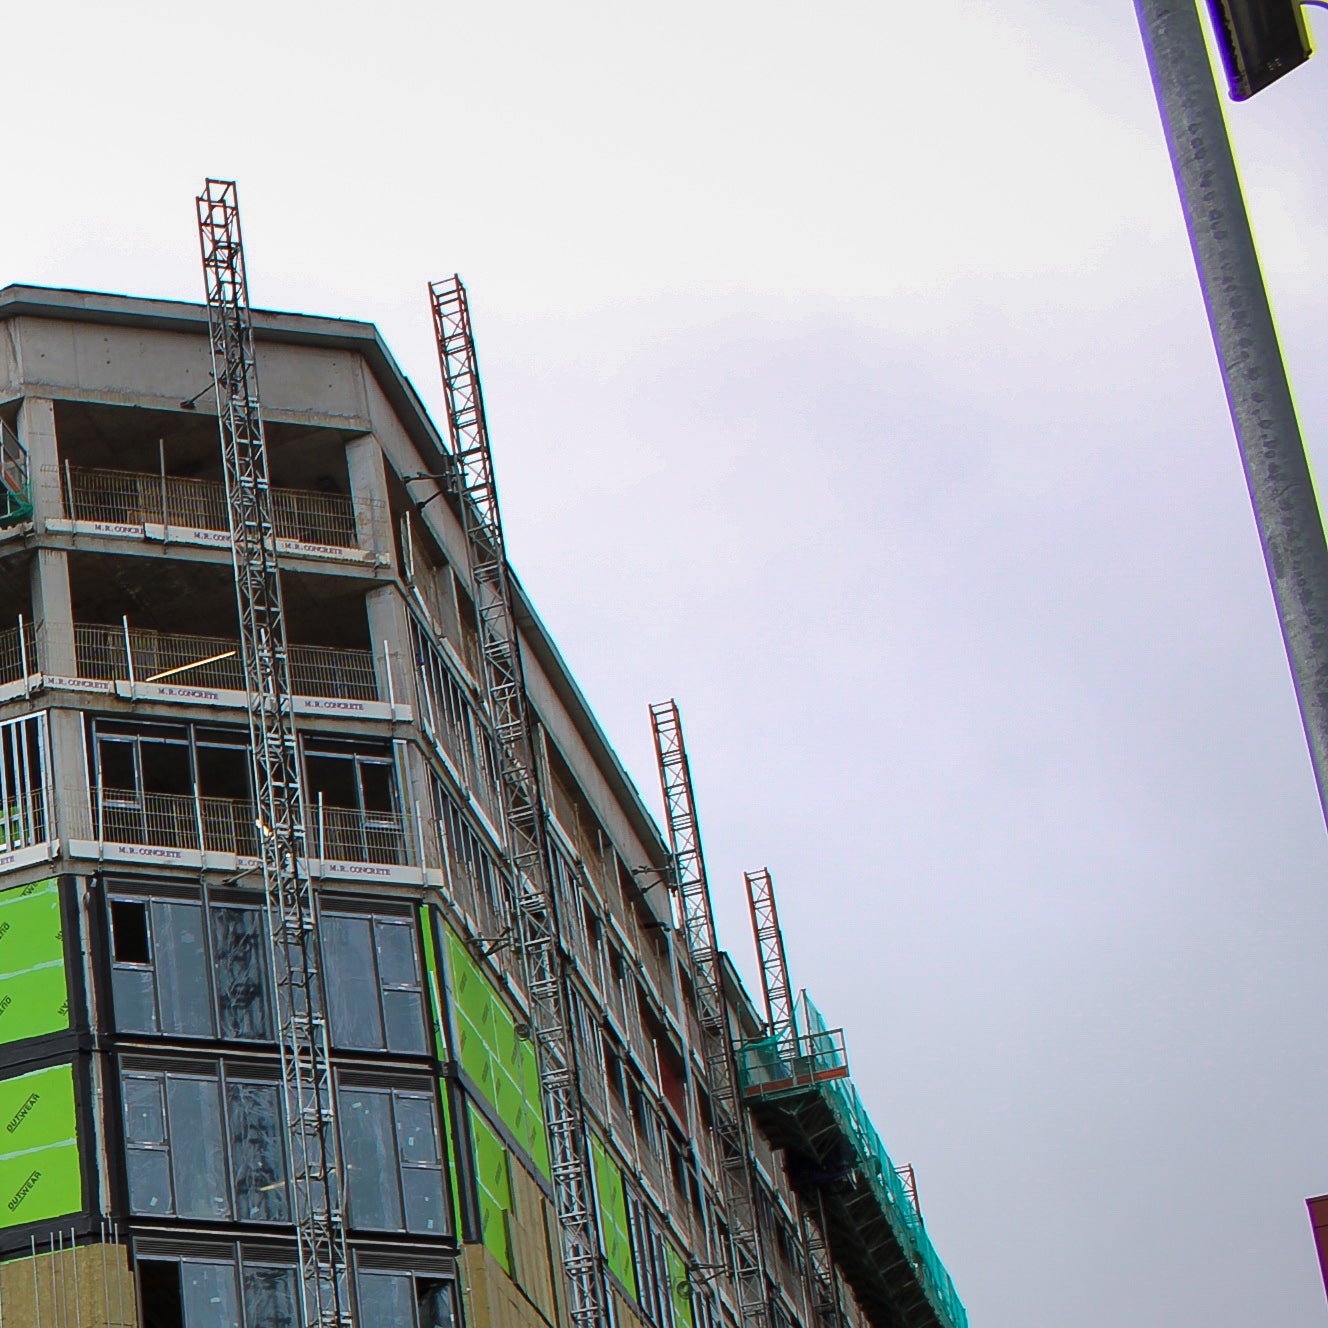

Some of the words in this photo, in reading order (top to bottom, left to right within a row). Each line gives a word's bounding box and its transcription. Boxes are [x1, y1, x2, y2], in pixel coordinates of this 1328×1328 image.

[303, 544, 343, 554] CONCRETE
[67, 679, 108, 689] CONCRETE
[177, 689, 218, 699] CONCRETE
[323, 702, 363, 711] CONCRETE
[139, 849, 181, 859] CONCRETE
[349, 866, 391, 876] CONCRETE
[6, 1093, 40, 1133] OUTWEAR
[7, 1171, 41, 1211] OUTWEAR
